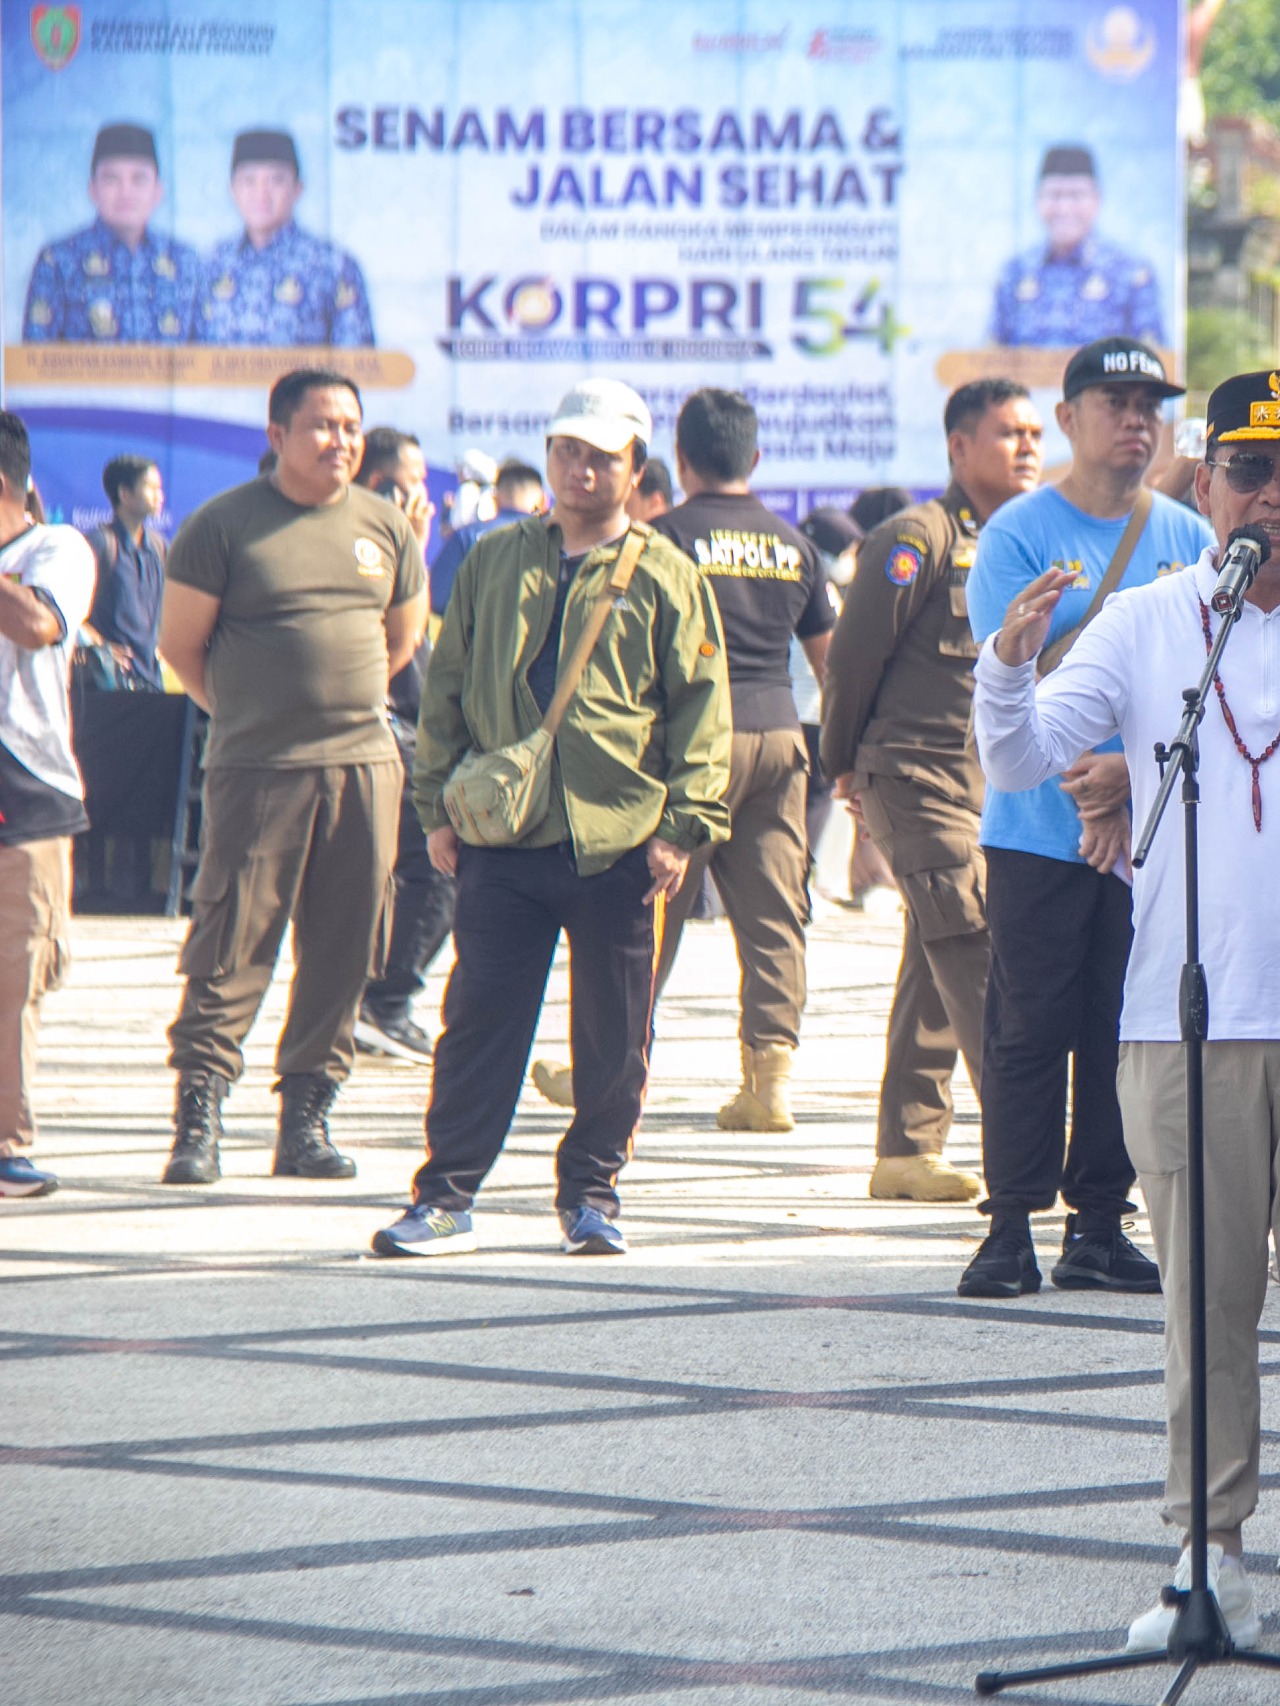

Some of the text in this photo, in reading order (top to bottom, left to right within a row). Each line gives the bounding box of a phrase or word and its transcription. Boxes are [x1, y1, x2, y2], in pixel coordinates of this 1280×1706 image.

[335, 107, 900, 151] SENAM BERSAMA &
[510, 164, 902, 208] JALAN SEHAT
[445, 275, 911, 357] KORPRI 54
[1103, 351, 1128, 373] NO
[694, 538, 775, 569] SATPOL
[773, 544, 803, 573] PP
